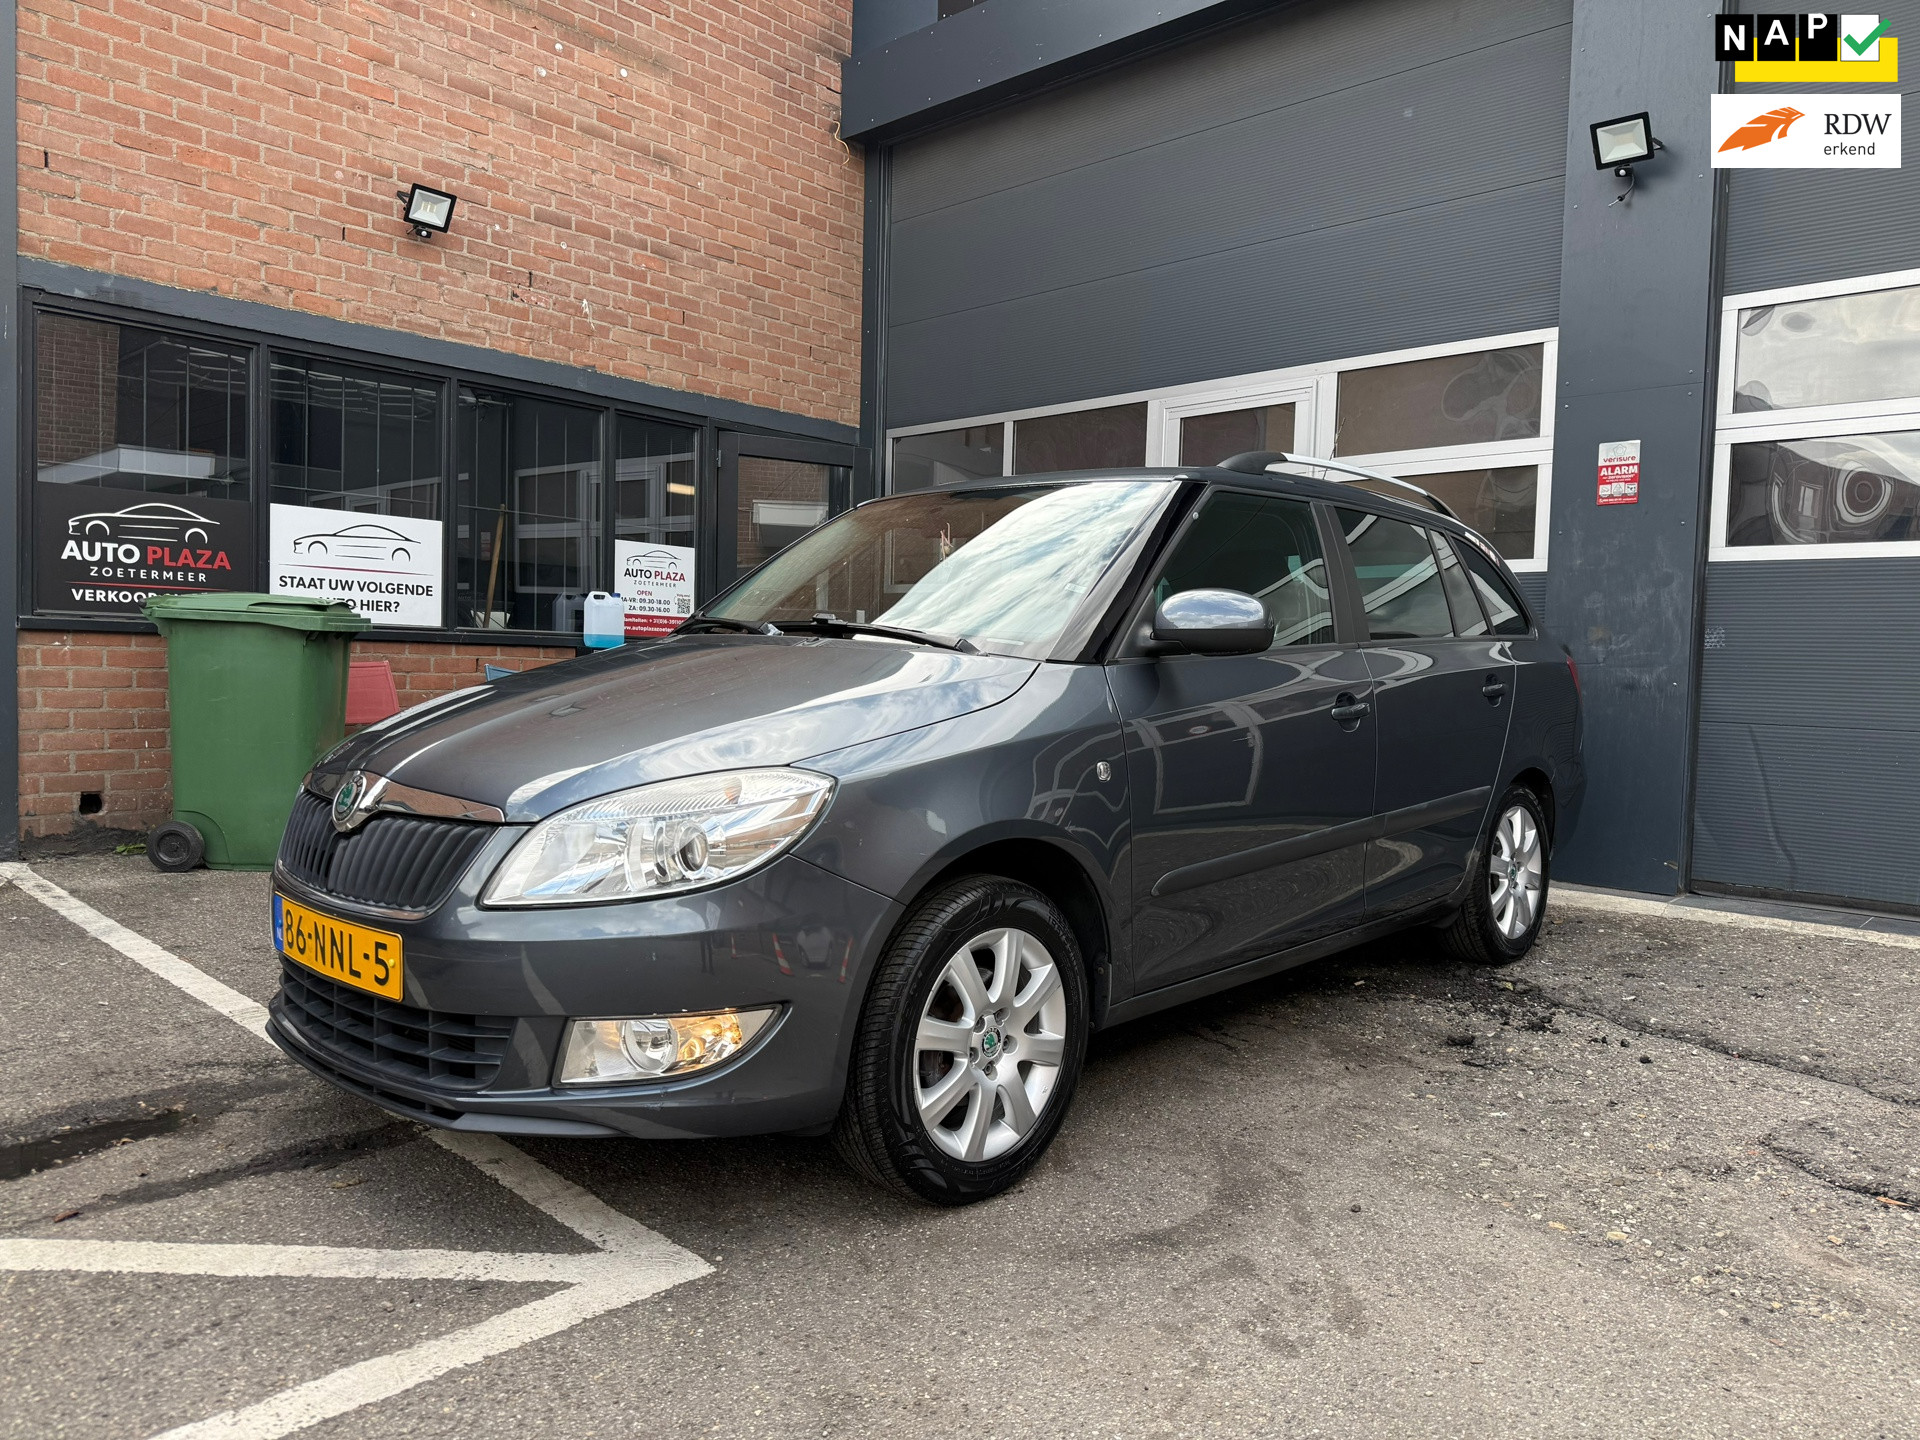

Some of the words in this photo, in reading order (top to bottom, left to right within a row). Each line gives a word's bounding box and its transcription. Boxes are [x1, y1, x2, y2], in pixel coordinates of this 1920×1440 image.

[1603, 455, 1637, 463] verisure
[1600, 465, 1638, 476] ALARM
[61, 540, 141, 564] AUTO
[147, 546, 232, 570] PLAZA
[90, 566, 207, 582] ZOETERMEER
[624, 568, 652, 579] AUTO
[654, 570, 686, 582] PLAZA
[279, 575, 326, 590] STAAT
[328, 579, 355, 592] UW
[357, 580, 434, 597] VOLGENDE
[633, 580, 677, 588] ZOETERMEER
[636, 589, 653, 597] OPEN
[360, 599, 400, 613] HIER?
[285, 908, 390, 986] 86-NNL-5
